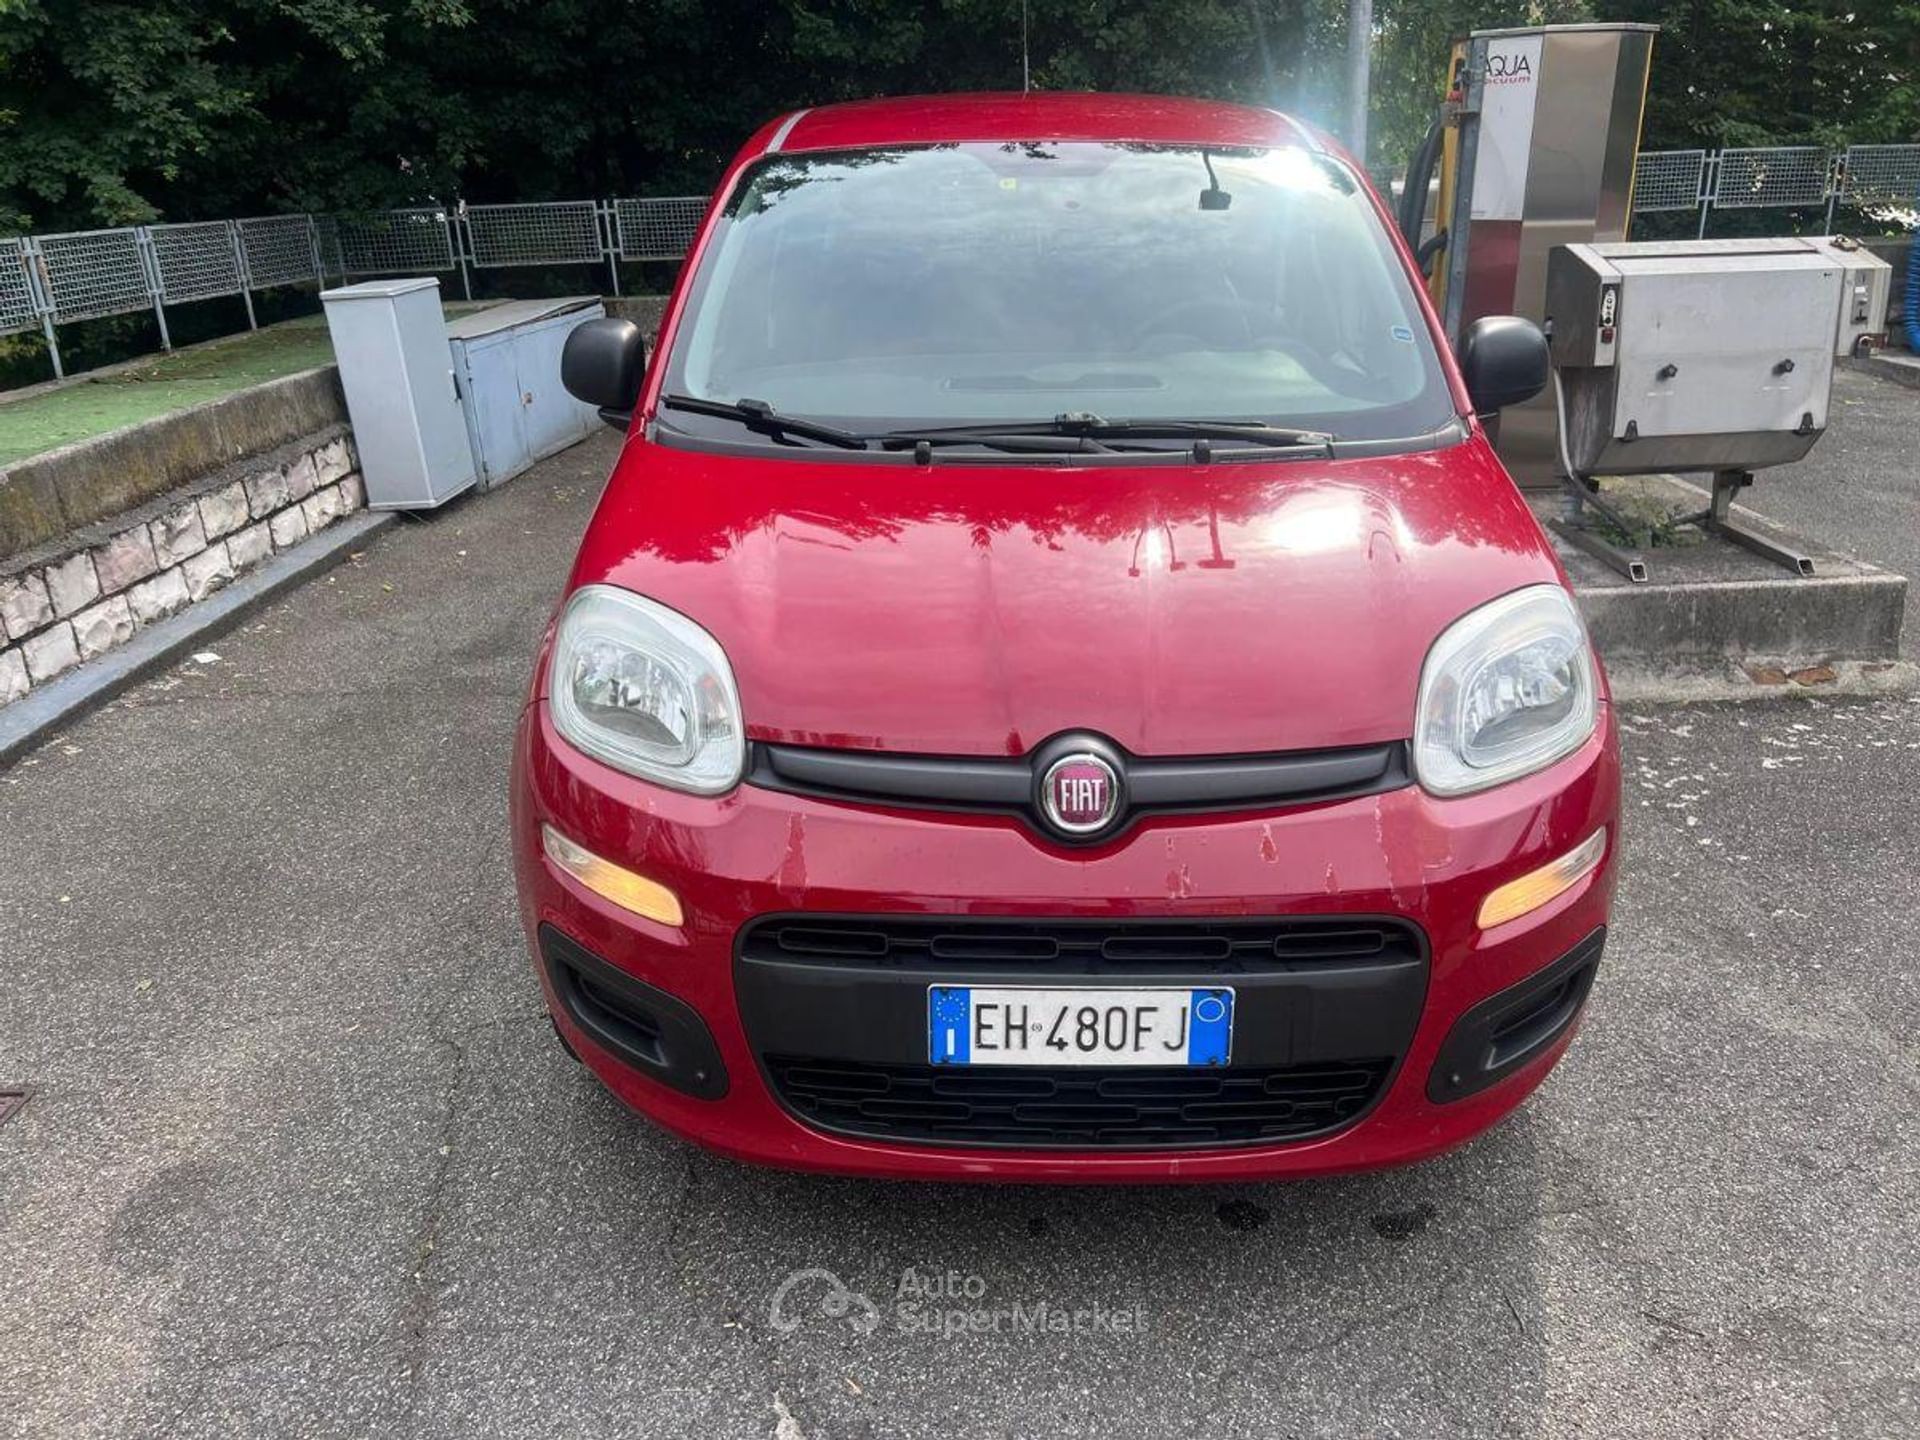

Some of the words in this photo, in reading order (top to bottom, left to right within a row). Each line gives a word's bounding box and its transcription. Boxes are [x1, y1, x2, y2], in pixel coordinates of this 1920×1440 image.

[1485, 76, 1531, 84] acuum
[1061, 779, 1103, 811] FIAT
[974, 1003, 1028, 1050] EH
[1045, 1005, 1187, 1052] 480FJ
